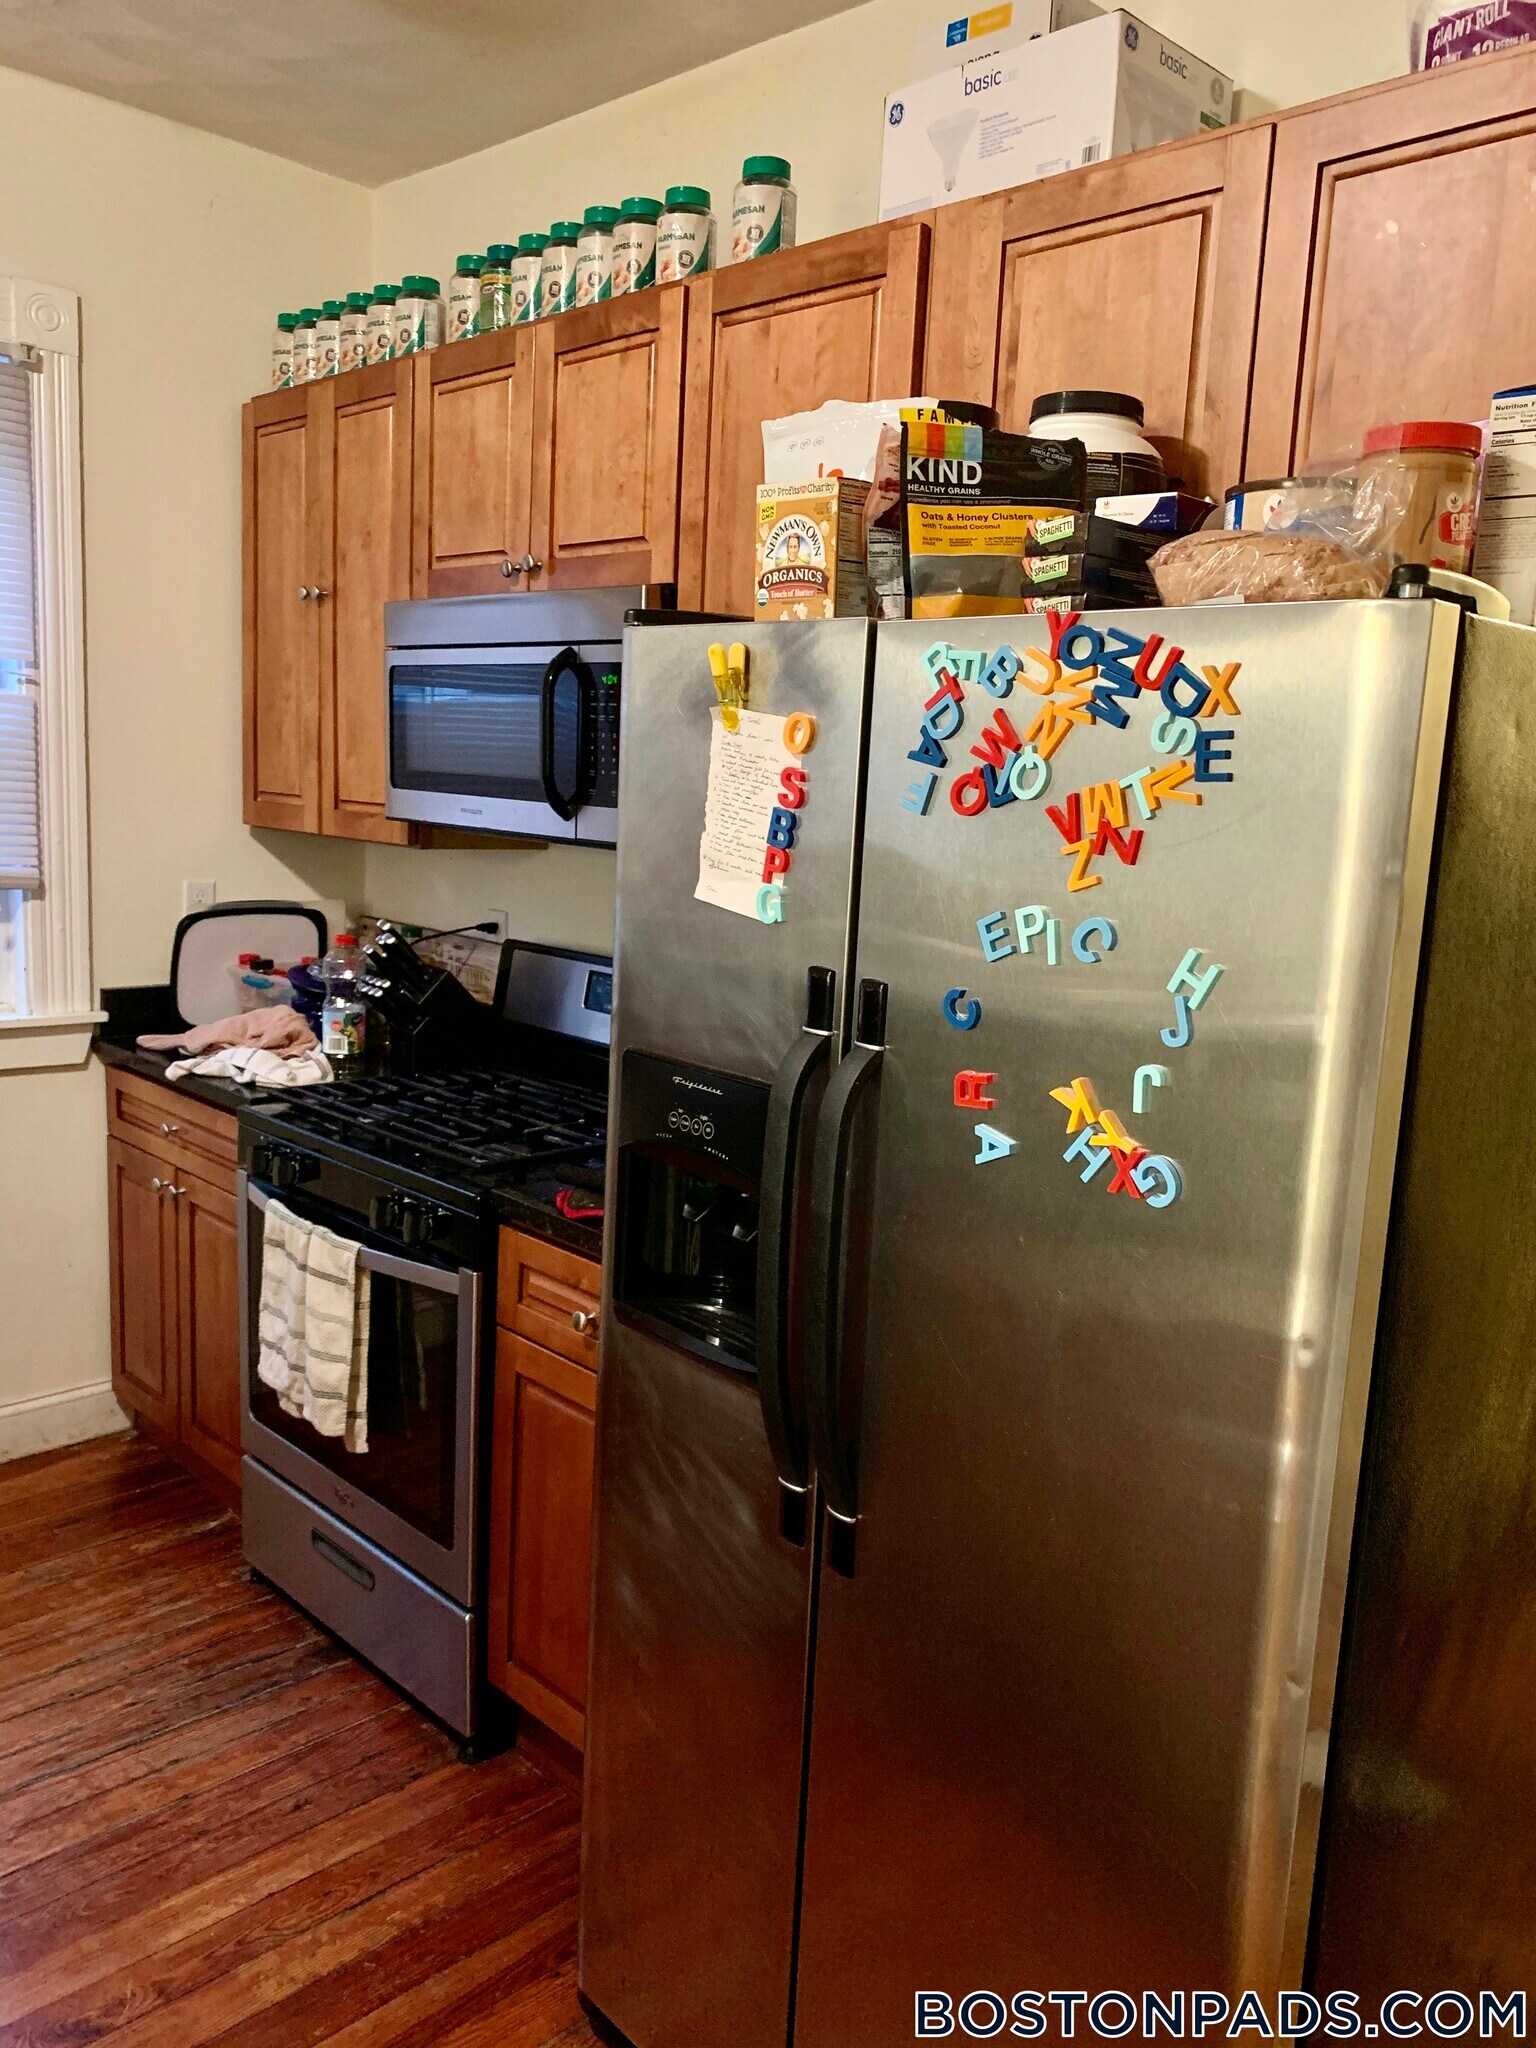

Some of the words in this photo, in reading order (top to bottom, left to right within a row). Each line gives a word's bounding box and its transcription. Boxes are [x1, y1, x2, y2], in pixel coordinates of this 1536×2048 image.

[1433, 13, 1473, 51] GIANT
[1475, 0, 1511, 30] ROLL
[1160, 44, 1187, 79] basic
[964, 68, 1001, 97] basic
[1495, 403, 1528, 411] Nutrition
[777, 486, 800, 497] Profits
[807, 483, 835, 494] Charity
[906, 456, 982, 485] KIND
[908, 484, 945, 494] HEALTHY
[947, 487, 981, 495] GRAINS
[761, 512, 775, 521] GMO
[762, 505, 775, 514] NON
[921, 511, 944, 521] Oats
[946, 513, 954, 521] &
[956, 512, 989, 522] Honey
[991, 512, 1033, 521] Clusters
[1039, 521, 1073, 539] SPAGHETTI
[805, 525, 822, 558] OWN
[763, 568, 823, 588] ORGANICS
[1034, 559, 1067, 577] SPAGHETTI
[770, 590, 787, 599] Touch
[795, 588, 814, 597] Butter
[1036, 601, 1069, 613] SPAGHETTI
[1046, 610, 1081, 659] Y
[1059, 624, 1104, 670] O
[979, 644, 1024, 698] B
[1133, 633, 1185, 690] U
[1161, 662, 1212, 717] D
[1201, 662, 1242, 718] X
[783, 711, 816, 755] O
[923, 693, 964, 740] D
[1151, 712, 1202, 757] S
[907, 725, 948, 768] A
[1195, 730, 1235, 782] E
[777, 766, 807, 810] S
[766, 806, 798, 849] B
[1045, 793, 1081, 844] V
[761, 845, 792, 884] P
[756, 883, 787, 925] G
[1165, 947, 1226, 1010] H
[1160, 995, 1194, 1048] J
[672, 1076, 723, 1095] Frigidaire
[974, 1123, 1018, 1164] A
